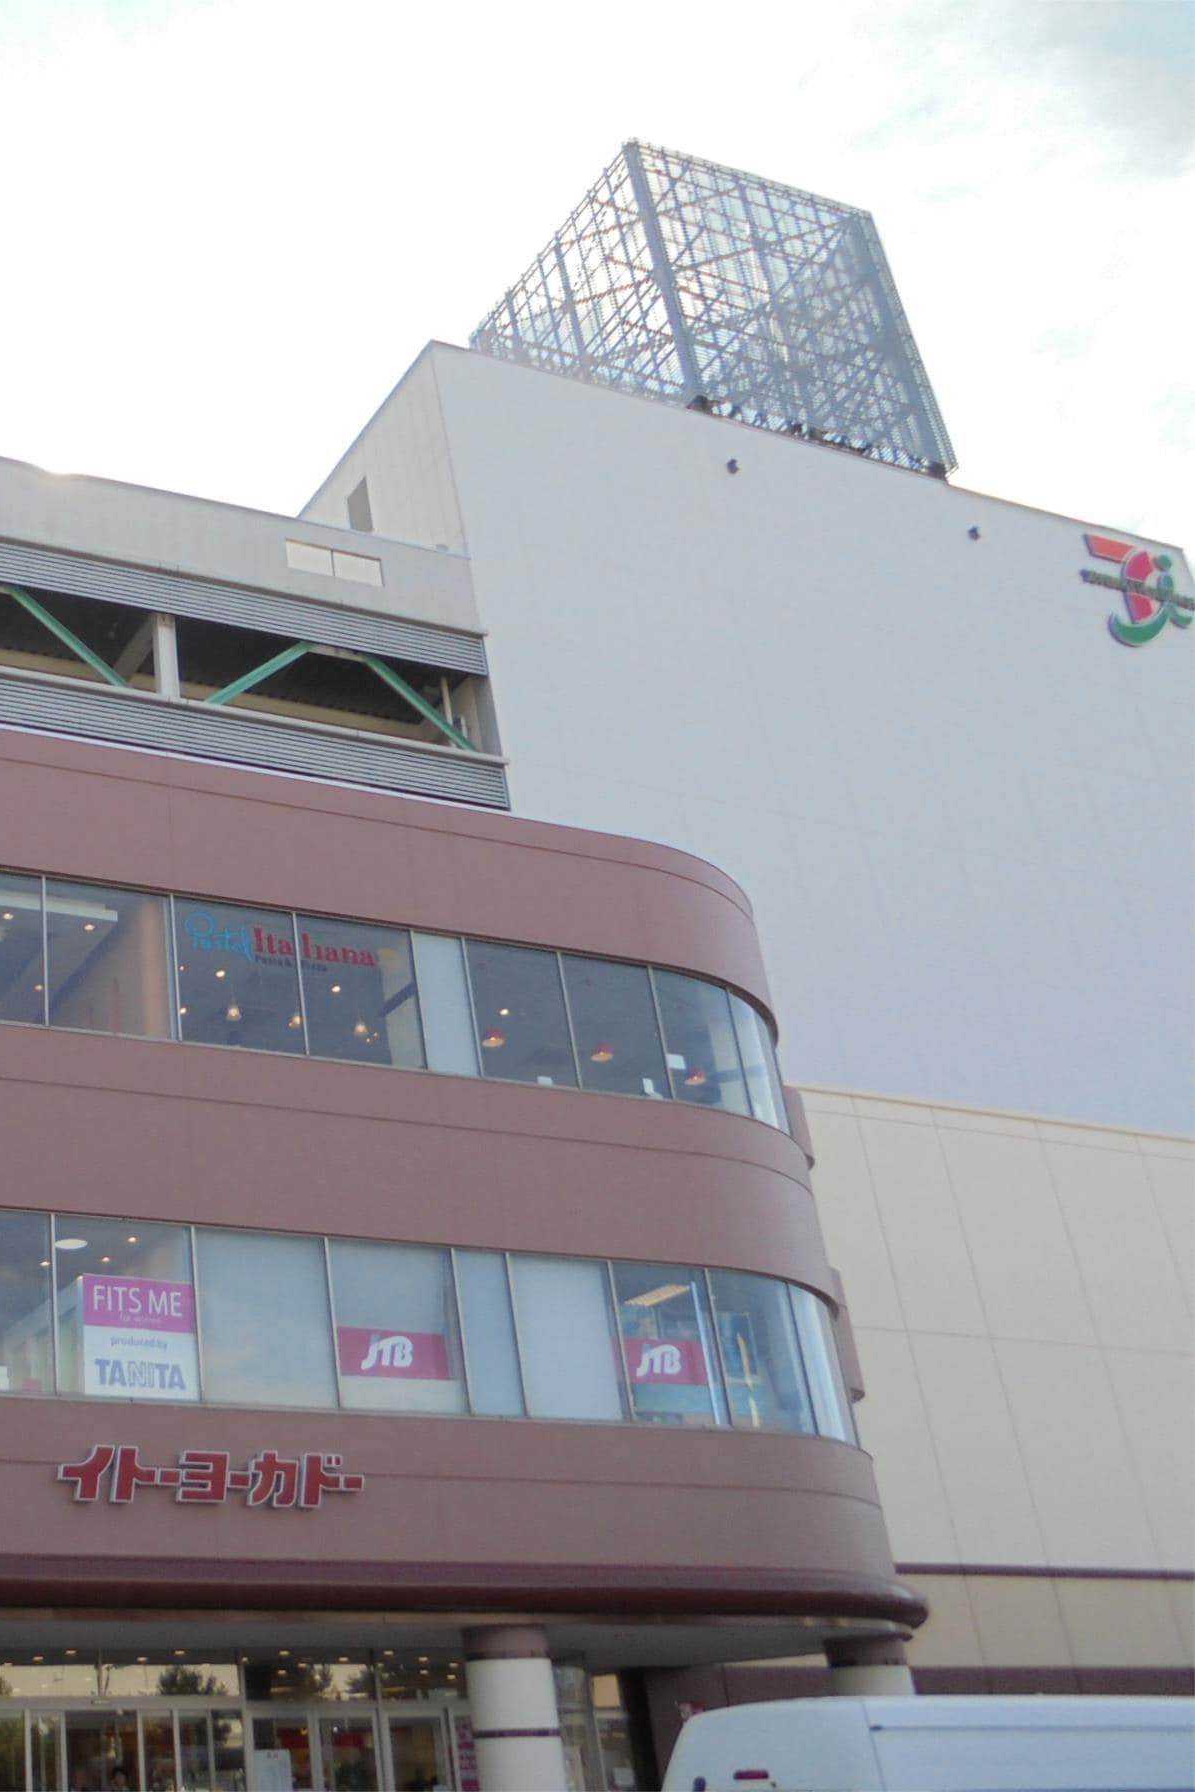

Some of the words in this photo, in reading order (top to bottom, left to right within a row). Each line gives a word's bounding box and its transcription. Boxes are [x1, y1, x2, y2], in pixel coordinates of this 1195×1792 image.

[254, 926, 377, 967] Italiana
[93, 1284, 143, 1313] FITS
[148, 1288, 183, 1317] ME
[360, 1335, 413, 1370] JTB
[636, 1343, 682, 1377] JTB
[94, 1358, 186, 1391] TANITA
[57, 1444, 365, 1507] イトーヨーカドー
